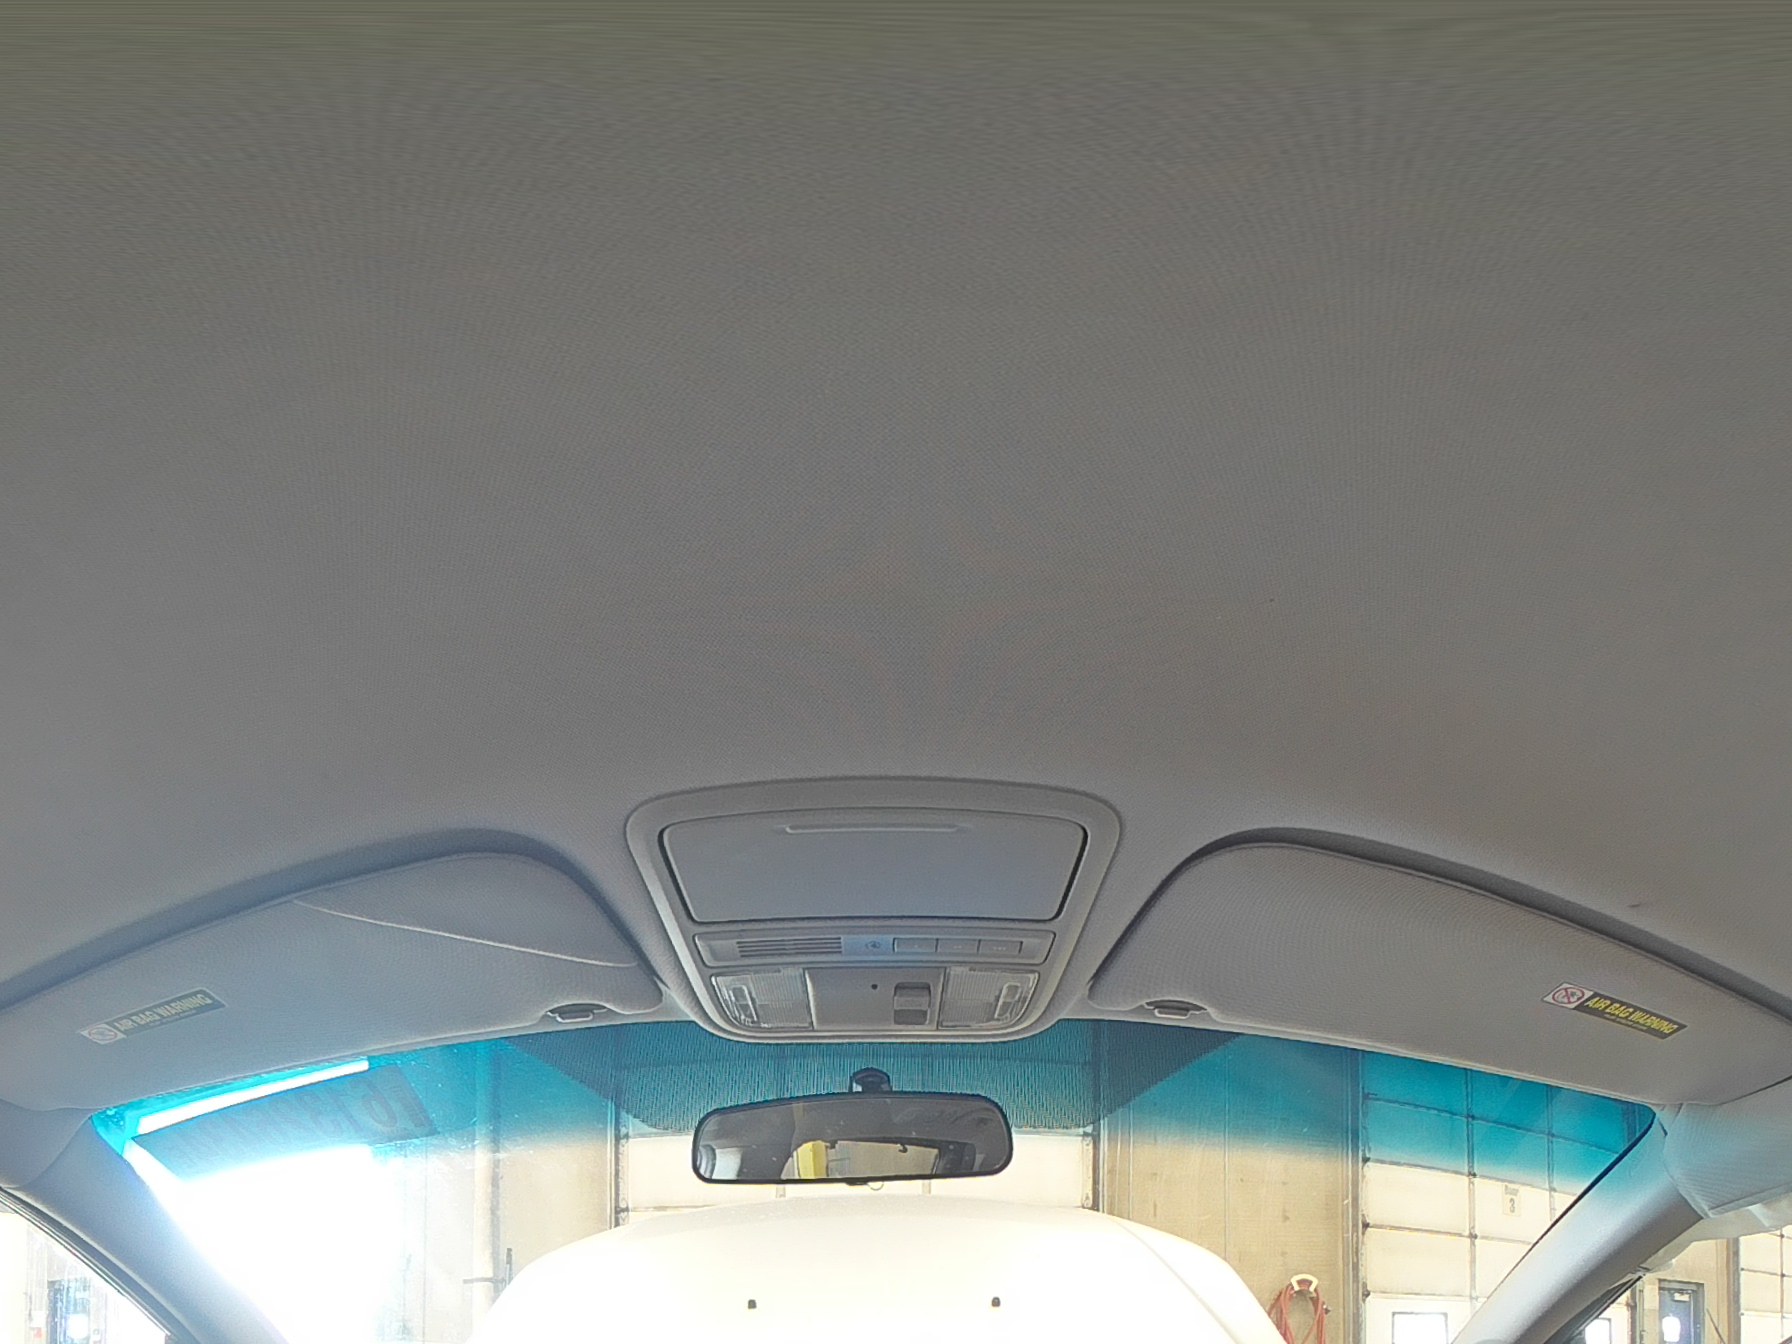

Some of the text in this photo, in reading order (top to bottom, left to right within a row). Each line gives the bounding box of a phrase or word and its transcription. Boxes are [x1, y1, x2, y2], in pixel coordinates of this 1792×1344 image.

[113, 1018, 139, 1032] AIR
[130, 1010, 162, 1025] BAG
[153, 993, 214, 1017] WARNING
[1583, 996, 1611, 1011] AIR
[1605, 1002, 1635, 1018] BAG
[1628, 1010, 1680, 1034] WARNING
[1509, 1197, 1516, 1213] 3
